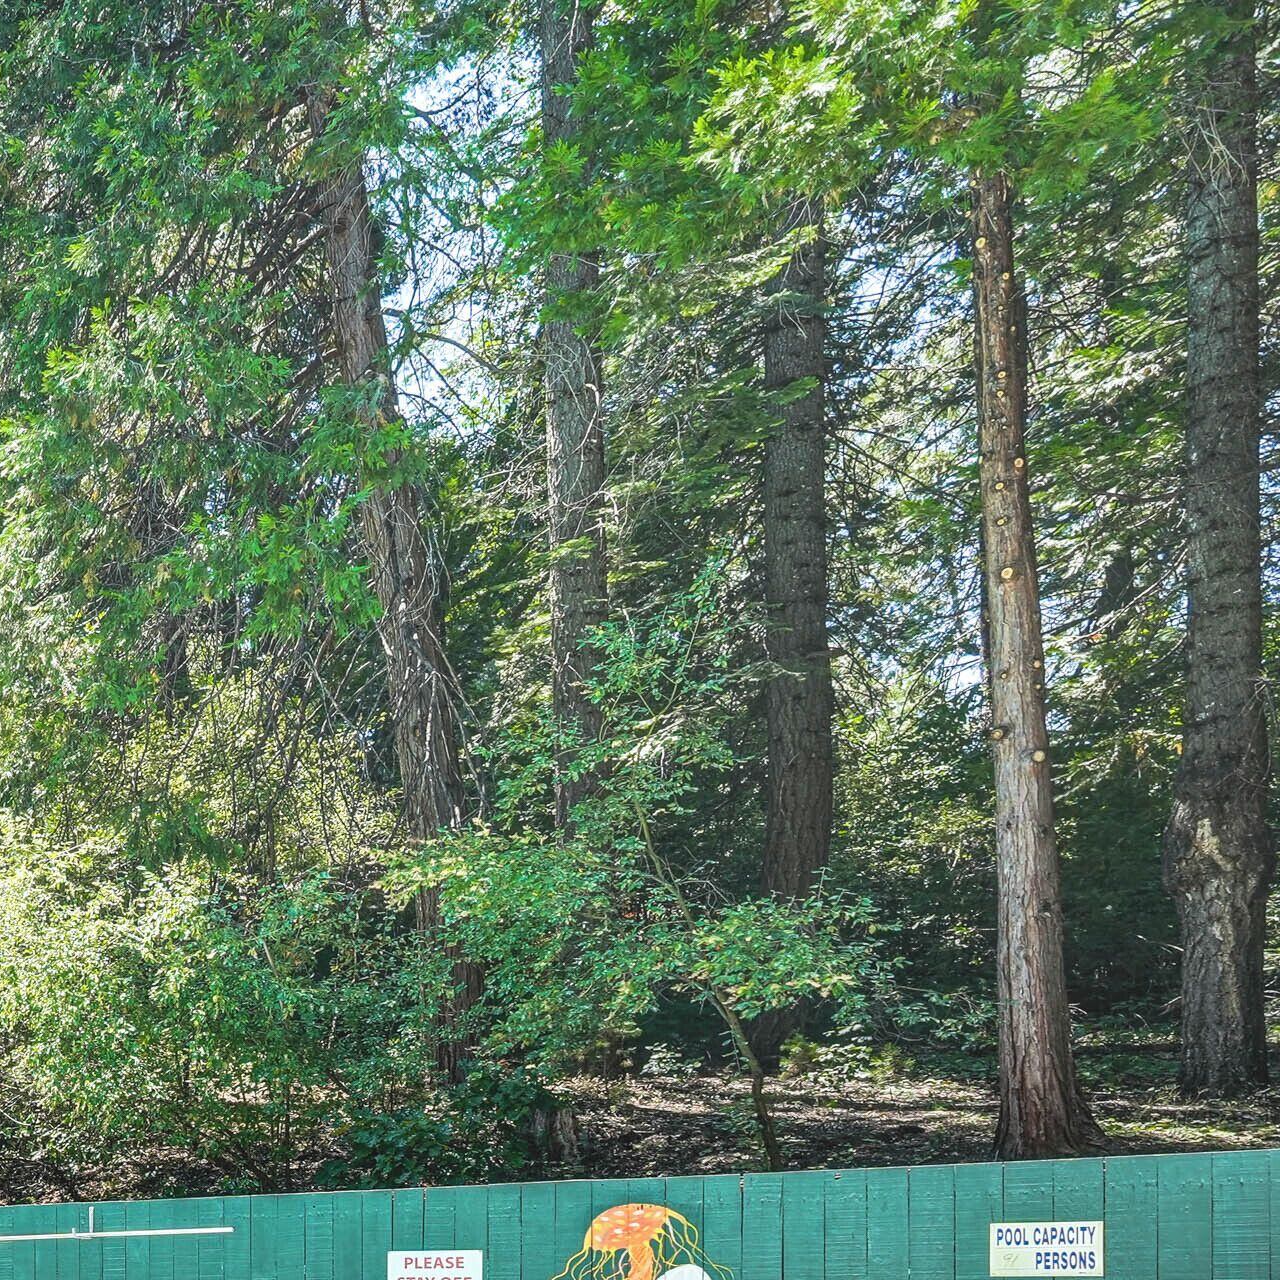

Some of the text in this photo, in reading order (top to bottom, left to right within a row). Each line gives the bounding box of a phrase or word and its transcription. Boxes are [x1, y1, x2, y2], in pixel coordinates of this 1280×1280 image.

[997, 1226, 1096, 1246] POOL CAPACITY
[404, 1257, 464, 1269] PLEASE
[1035, 1251, 1096, 1270] PERSONS
